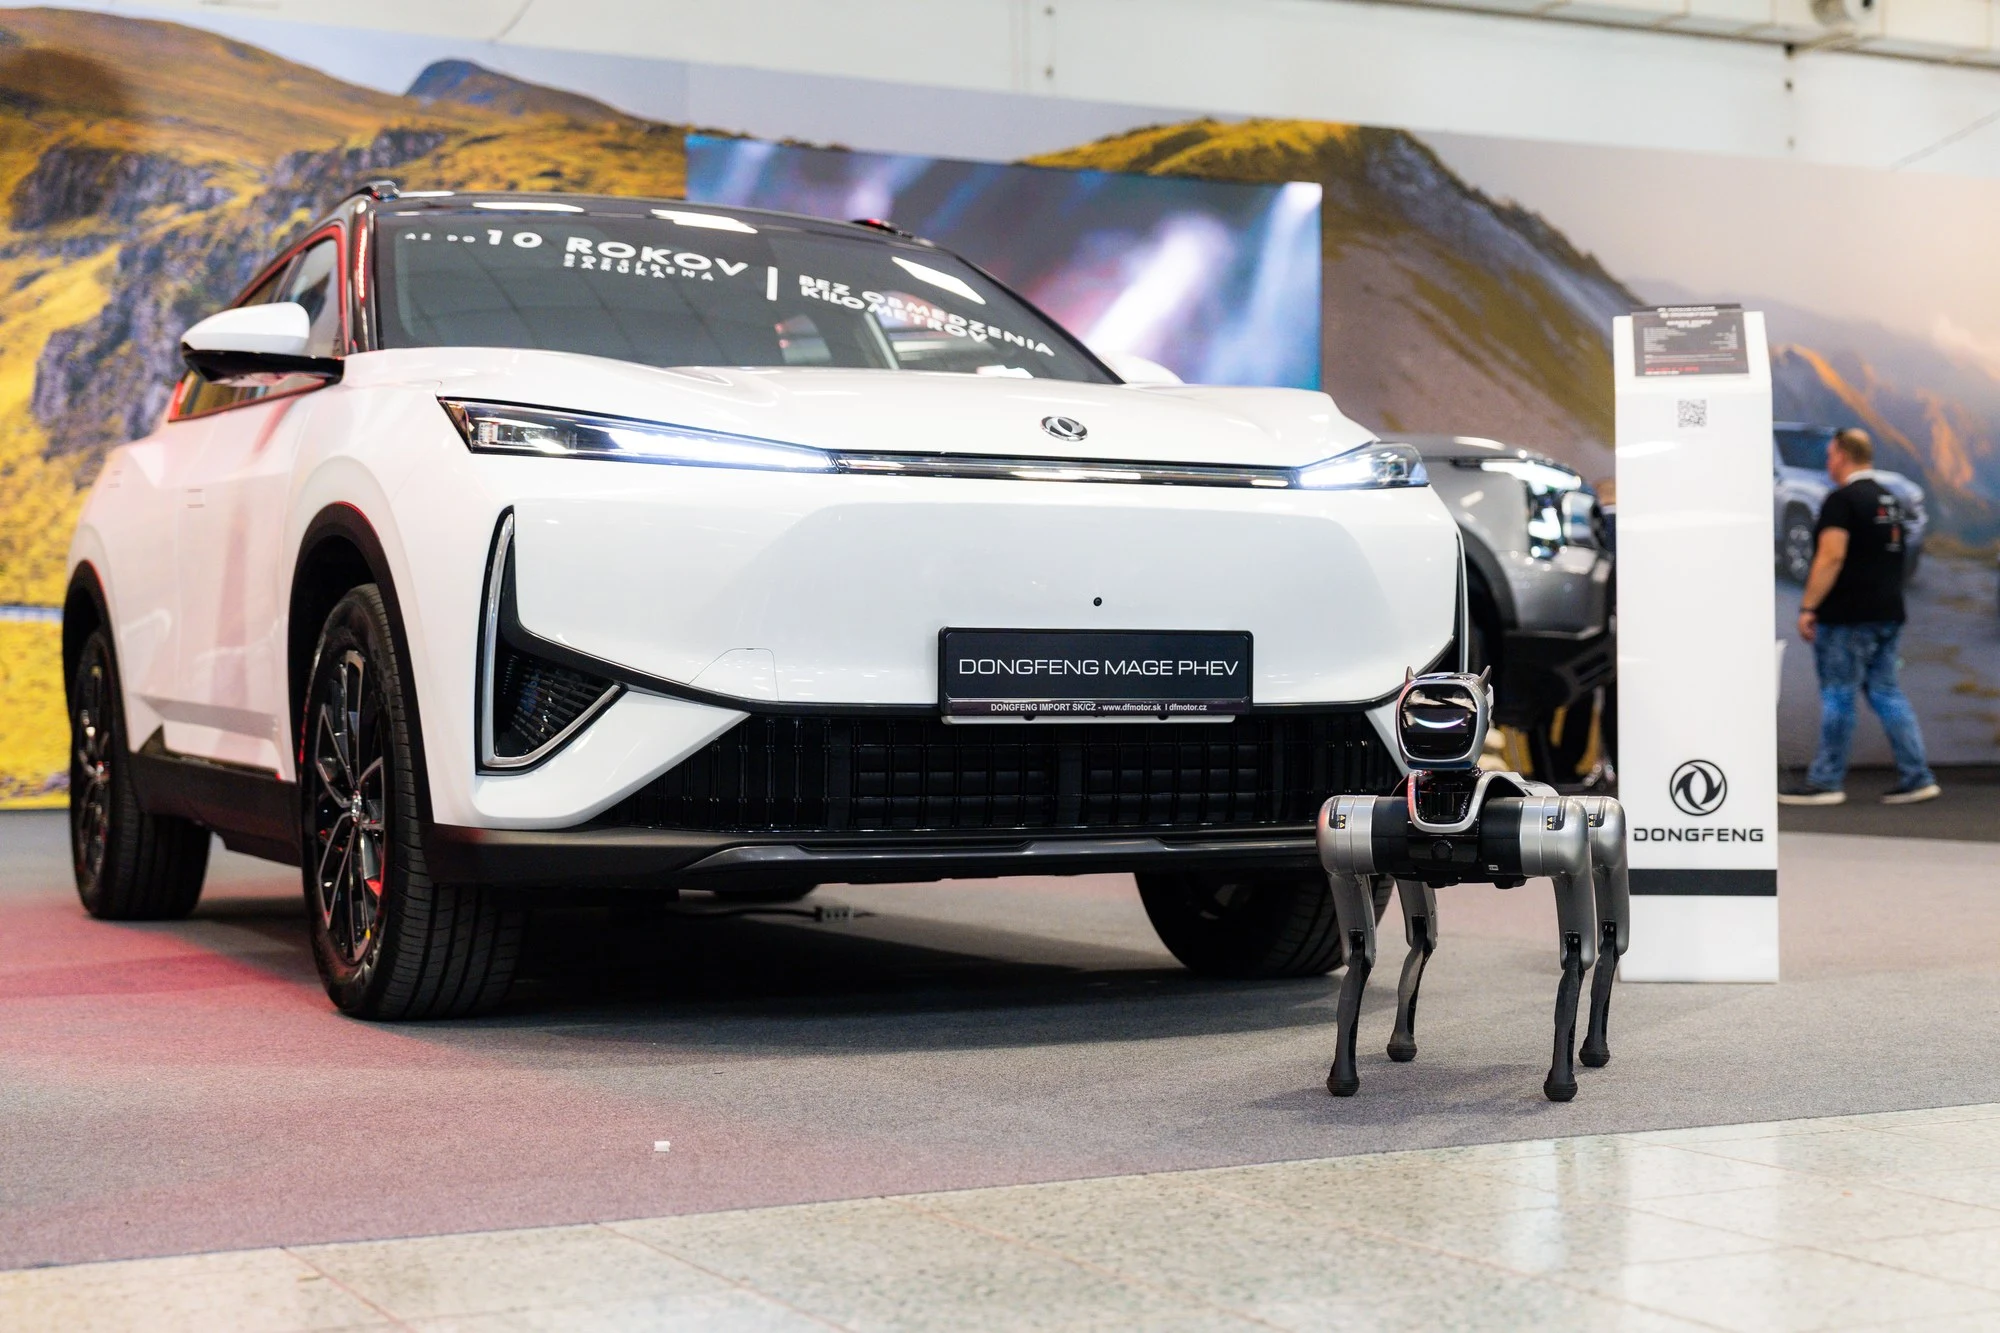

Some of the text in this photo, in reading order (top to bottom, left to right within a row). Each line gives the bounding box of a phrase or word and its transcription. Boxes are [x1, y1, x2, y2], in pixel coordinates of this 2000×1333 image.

[487, 229, 543, 248] 10
[565, 236, 749, 276] ROKOV
[959, 658, 1239, 676] DONGFENG MAGE PHEV
[990, 703, 1038, 711] DONGFENG
[1039, 703, 1071, 711] IMPORT
[1072, 703, 1096, 712] SK/CZ
[1102, 703, 1162, 711] www.dfmotor.sk
[1169, 703, 1207, 711] dfmotor.cz
[1633, 828, 1764, 842] DONGFENG
